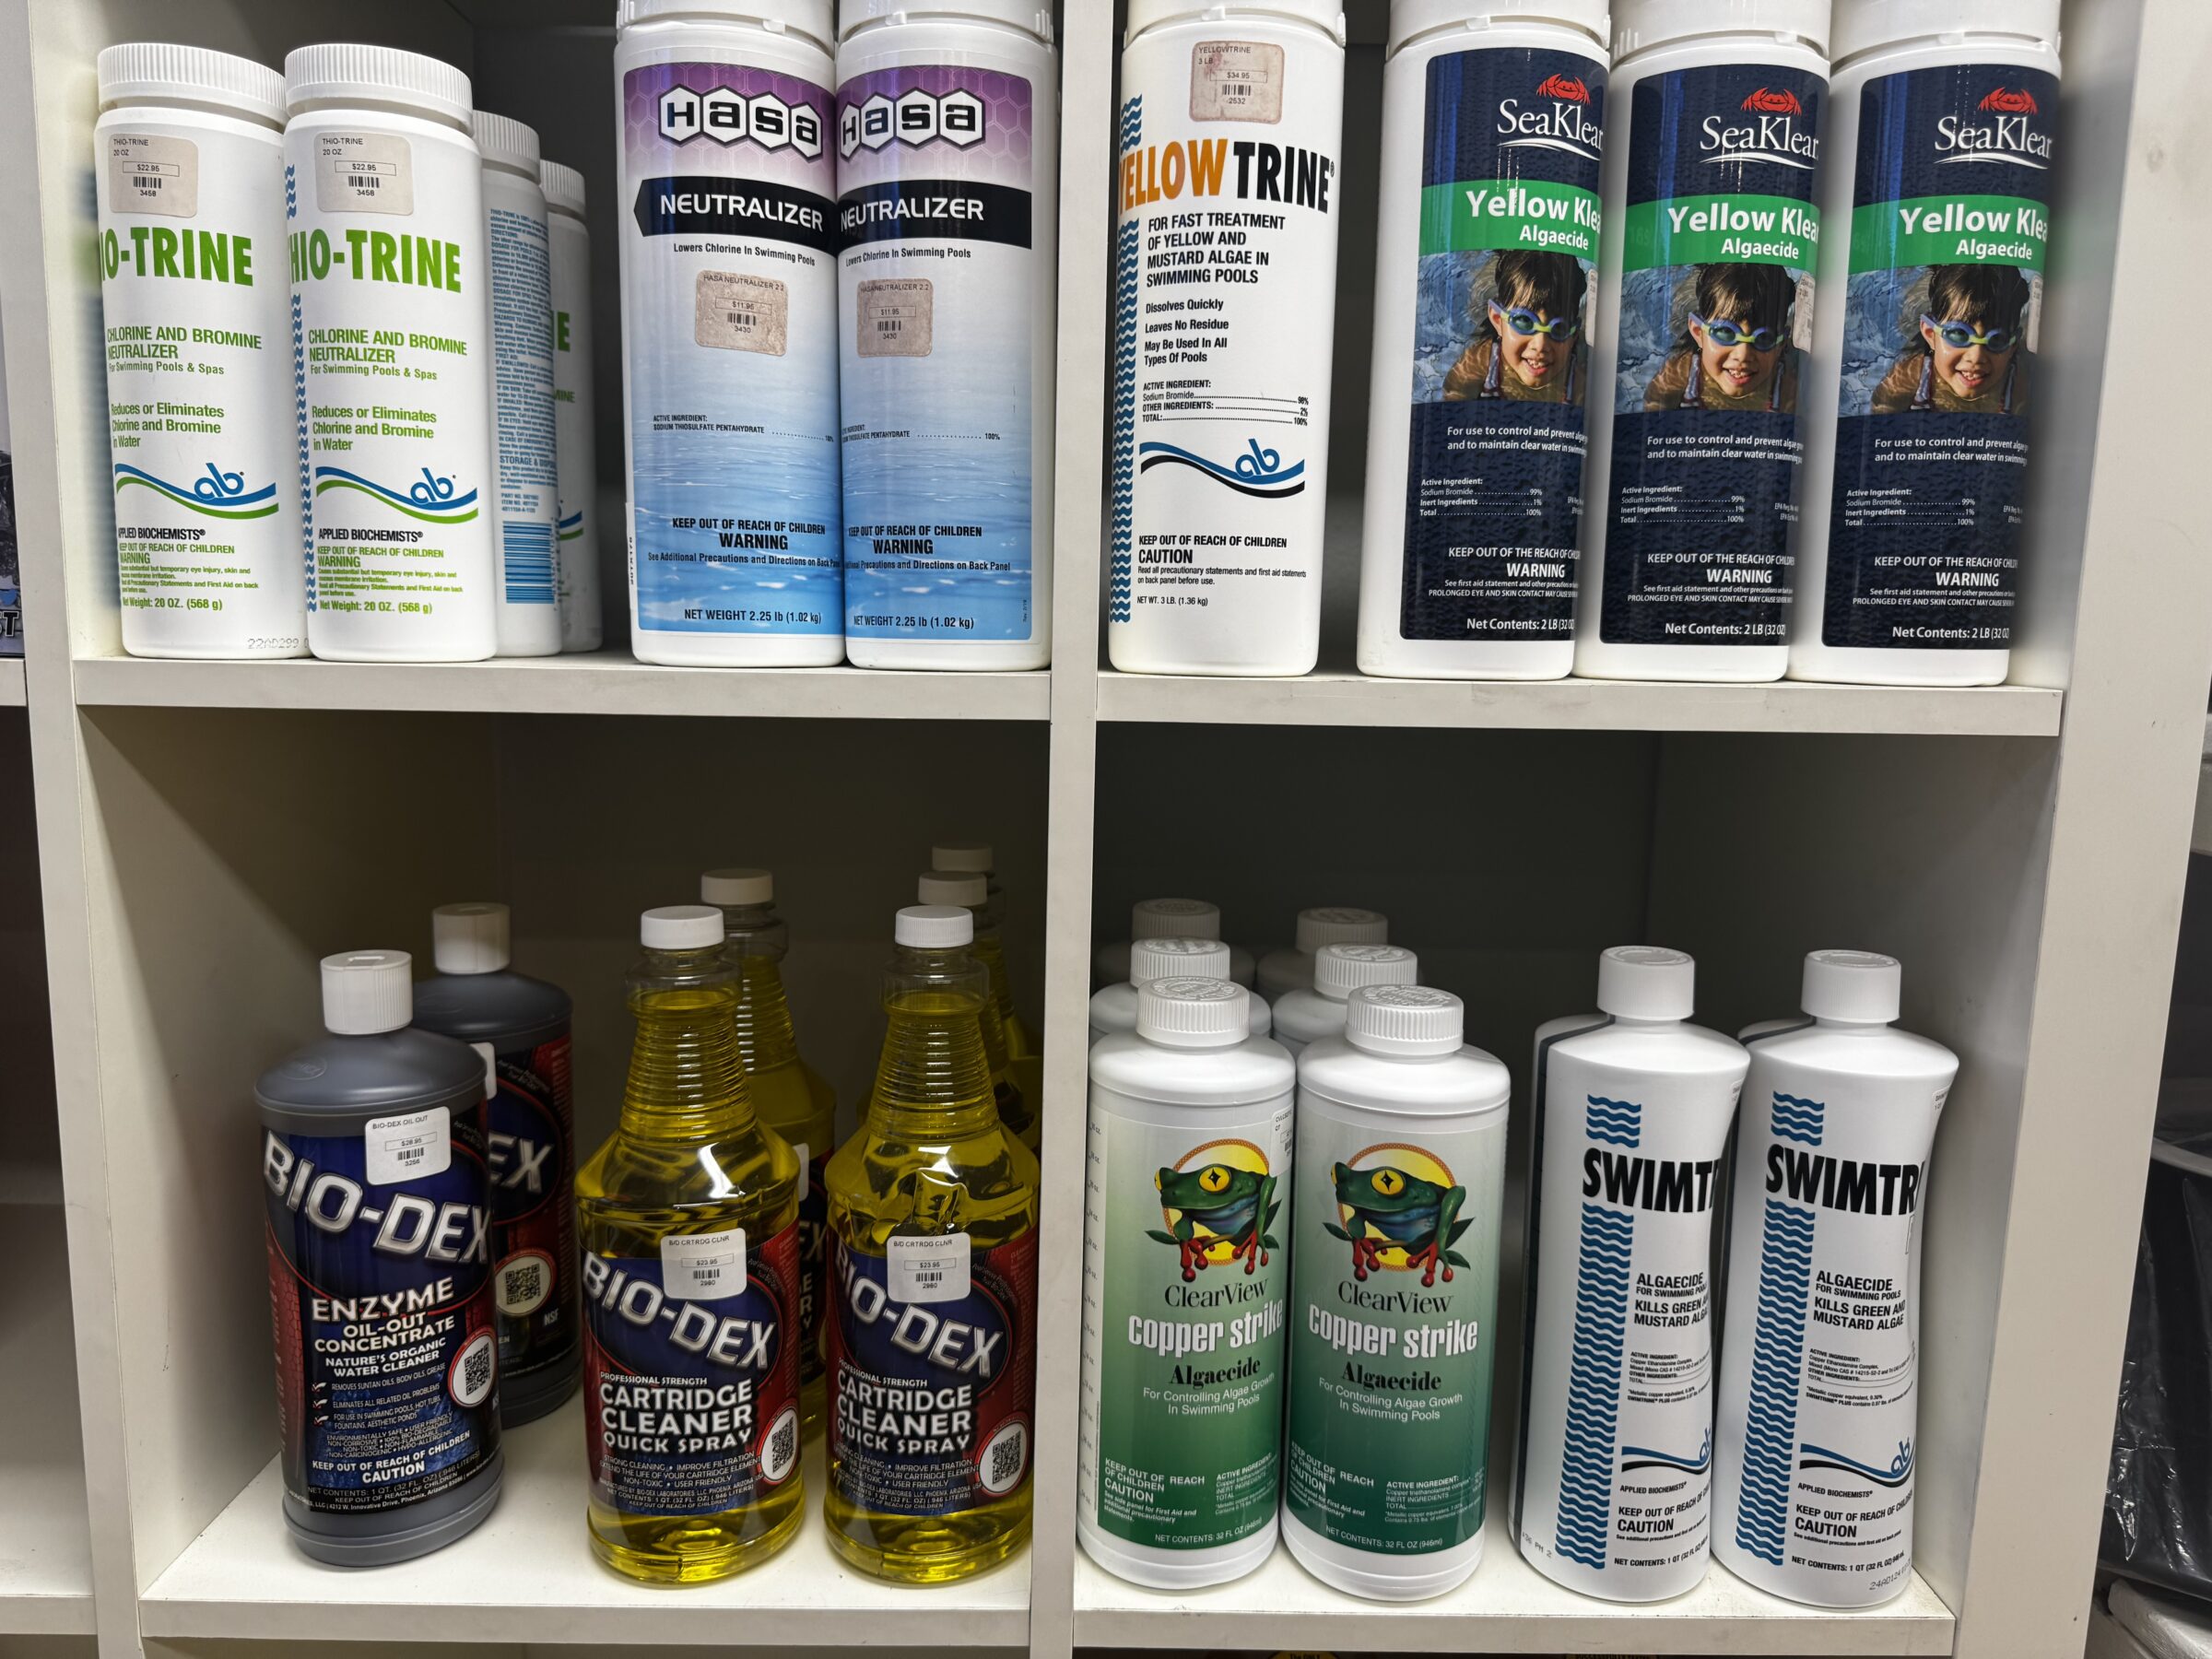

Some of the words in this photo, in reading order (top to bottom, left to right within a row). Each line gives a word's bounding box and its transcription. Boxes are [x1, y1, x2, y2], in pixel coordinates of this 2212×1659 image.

[1497, 99, 1603, 151] SeaKlear
[1700, 115, 1819, 160] SeaKlear
[1935, 115, 2053, 159] SeaKlear
[137, 164, 159, 172] $22.95
[352, 163, 376, 171] $22.95
[661, 194, 823, 231] NEUTRALIZER
[841, 197, 983, 231] NEUTRALIZER
[1465, 188, 1569, 220] Yellow
[1148, 218, 1168, 232] FOR
[1171, 214, 1203, 229] FAST
[1206, 213, 1286, 229] TREATMENT
[1668, 203, 1775, 233] Yellow
[1900, 204, 2011, 235] Yellow
[1147, 236, 1161, 251] OF
[1164, 232, 1214, 249] YELLOW
[1218, 232, 1246, 245] AND
[1519, 225, 1589, 250] Algaecide
[1721, 238, 1799, 259] Algaecide
[674, 242, 703, 253] Lowers
[705, 243, 741, 254] Chlorine
[744, 245, 752, 255] In
[755, 246, 795, 263] Swimming
[797, 253, 815, 266] Pools
[845, 254, 862, 267] Lowers
[863, 249, 889, 263] Chlorine
[891, 248, 899, 258] In
[901, 248, 945, 258] Swimming
[947, 248, 971, 258] Pools
[1147, 251, 1205, 269] MUSTARD
[1208, 251, 1252, 265] ALGAE
[1256, 253, 1269, 265] IN
[1956, 239, 2032, 260] Algaecide
[1147, 270, 1211, 288] SWIMMING
[1215, 270, 1258, 284] POOLS
[1146, 301, 1184, 313] Dissolves
[1187, 299, 1224, 311] Quickly
[1145, 323, 1172, 334] Leaves
[1175, 320, 1187, 331] No
[1190, 319, 1229, 330] Residue
[309, 329, 368, 344] CHLORINE
[373, 330, 405, 346] AND
[409, 334, 467, 356] BROMINE
[310, 347, 395, 363] NEUTRALIZER
[312, 406, 354, 419] Reduces
[356, 407, 369, 418] or
[372, 406, 437, 423] Eliminates
[312, 422, 352, 435] Chlorine
[355, 423, 378, 435] and
[382, 424, 434, 439] Bromine
[319, 529, 348, 539] APPLIED
[673, 518, 696, 529] KEEP
[700, 519, 718, 529] OUT
[722, 519, 735, 530] OF
[738, 520, 771, 531] REACH
[774, 522, 785, 532] OF
[789, 523, 825, 534] CHILDREN
[719, 533, 788, 550] WARNING
[873, 539, 934, 554] WARNING
[1139, 549, 1193, 564] CAUTION
[1506, 563, 1565, 578] WARNING
[1707, 569, 1772, 583] WARNING
[1936, 572, 1999, 587] WARNING
[685, 610, 702, 619] NET
[706, 610, 747, 621] WEIGHT
[749, 611, 771, 621] 2.25
[774, 611, 782, 622] lb
[786, 612, 808, 624] (1.02
[810, 612, 821, 624] kg)
[1665, 623, 1686, 634] Net
[1688, 624, 1742, 634] Contents:
[1744, 625, 1750, 634] 2
[1753, 624, 1762, 634] LB
[372, 1120, 402, 1130] BIO-DEX
[416, 1115, 428, 1124] OUT
[265, 1130, 490, 1265] BIO-DEX
[1637, 1272, 1703, 1288] ALGAECIDE
[1817, 1270, 1893, 1290] ALGAECIDE
[312, 1275, 454, 1321] ENZYME
[1164, 1277, 1271, 1308] ClearView
[1338, 1280, 1454, 1314] ClearView
[582, 1253, 777, 1369] BIO-DEX
[835, 1242, 1003, 1379] BIO-DEX
[1815, 1297, 1849, 1313] KILLS
[1853, 1305, 1890, 1317] GREEN
[1892, 1300, 1906, 1315] AND
[343, 1312, 428, 1337] OIL-OUT
[1128, 1314, 1225, 1359] copper
[1230, 1300, 1283, 1348] strike
[1309, 1303, 1396, 1357] copper
[1403, 1320, 1478, 1359] strike
[1813, 1311, 1874, 1330] MUSTARD
[1877, 1314, 1904, 1330] ALGAE
[314, 1316, 454, 1353] CONCENTRATE
[325, 1354, 386, 1367] NATURE'S
[389, 1338, 446, 1360] ORGANIC
[334, 1360, 379, 1377] WATER
[382, 1350, 440, 1373] CLEANER
[600, 1371, 660, 1384] PROFESSIONAL
[662, 1377, 707, 1385] STRENGTH
[1169, 1357, 1261, 1389] Algaecide
[1341, 1361, 1441, 1391] Algaecide
[599, 1379, 753, 1411] CARTRIDGE
[837, 1371, 972, 1412] CARTRIDGE
[602, 1404, 753, 1435] CLEANER
[837, 1397, 972, 1437] CLEANER
[604, 1431, 669, 1453] QUICK
[678, 1427, 752, 1453] SPRAY
[837, 1418, 888, 1451] QUICK
[898, 1435, 971, 1453] SPRAY
[362, 1461, 425, 1484] CAUTION
[1105, 1477, 1154, 1503] CAUTION
[1618, 1519, 1674, 1534] CAUTION
[1795, 1517, 1857, 1538] CAUTION
